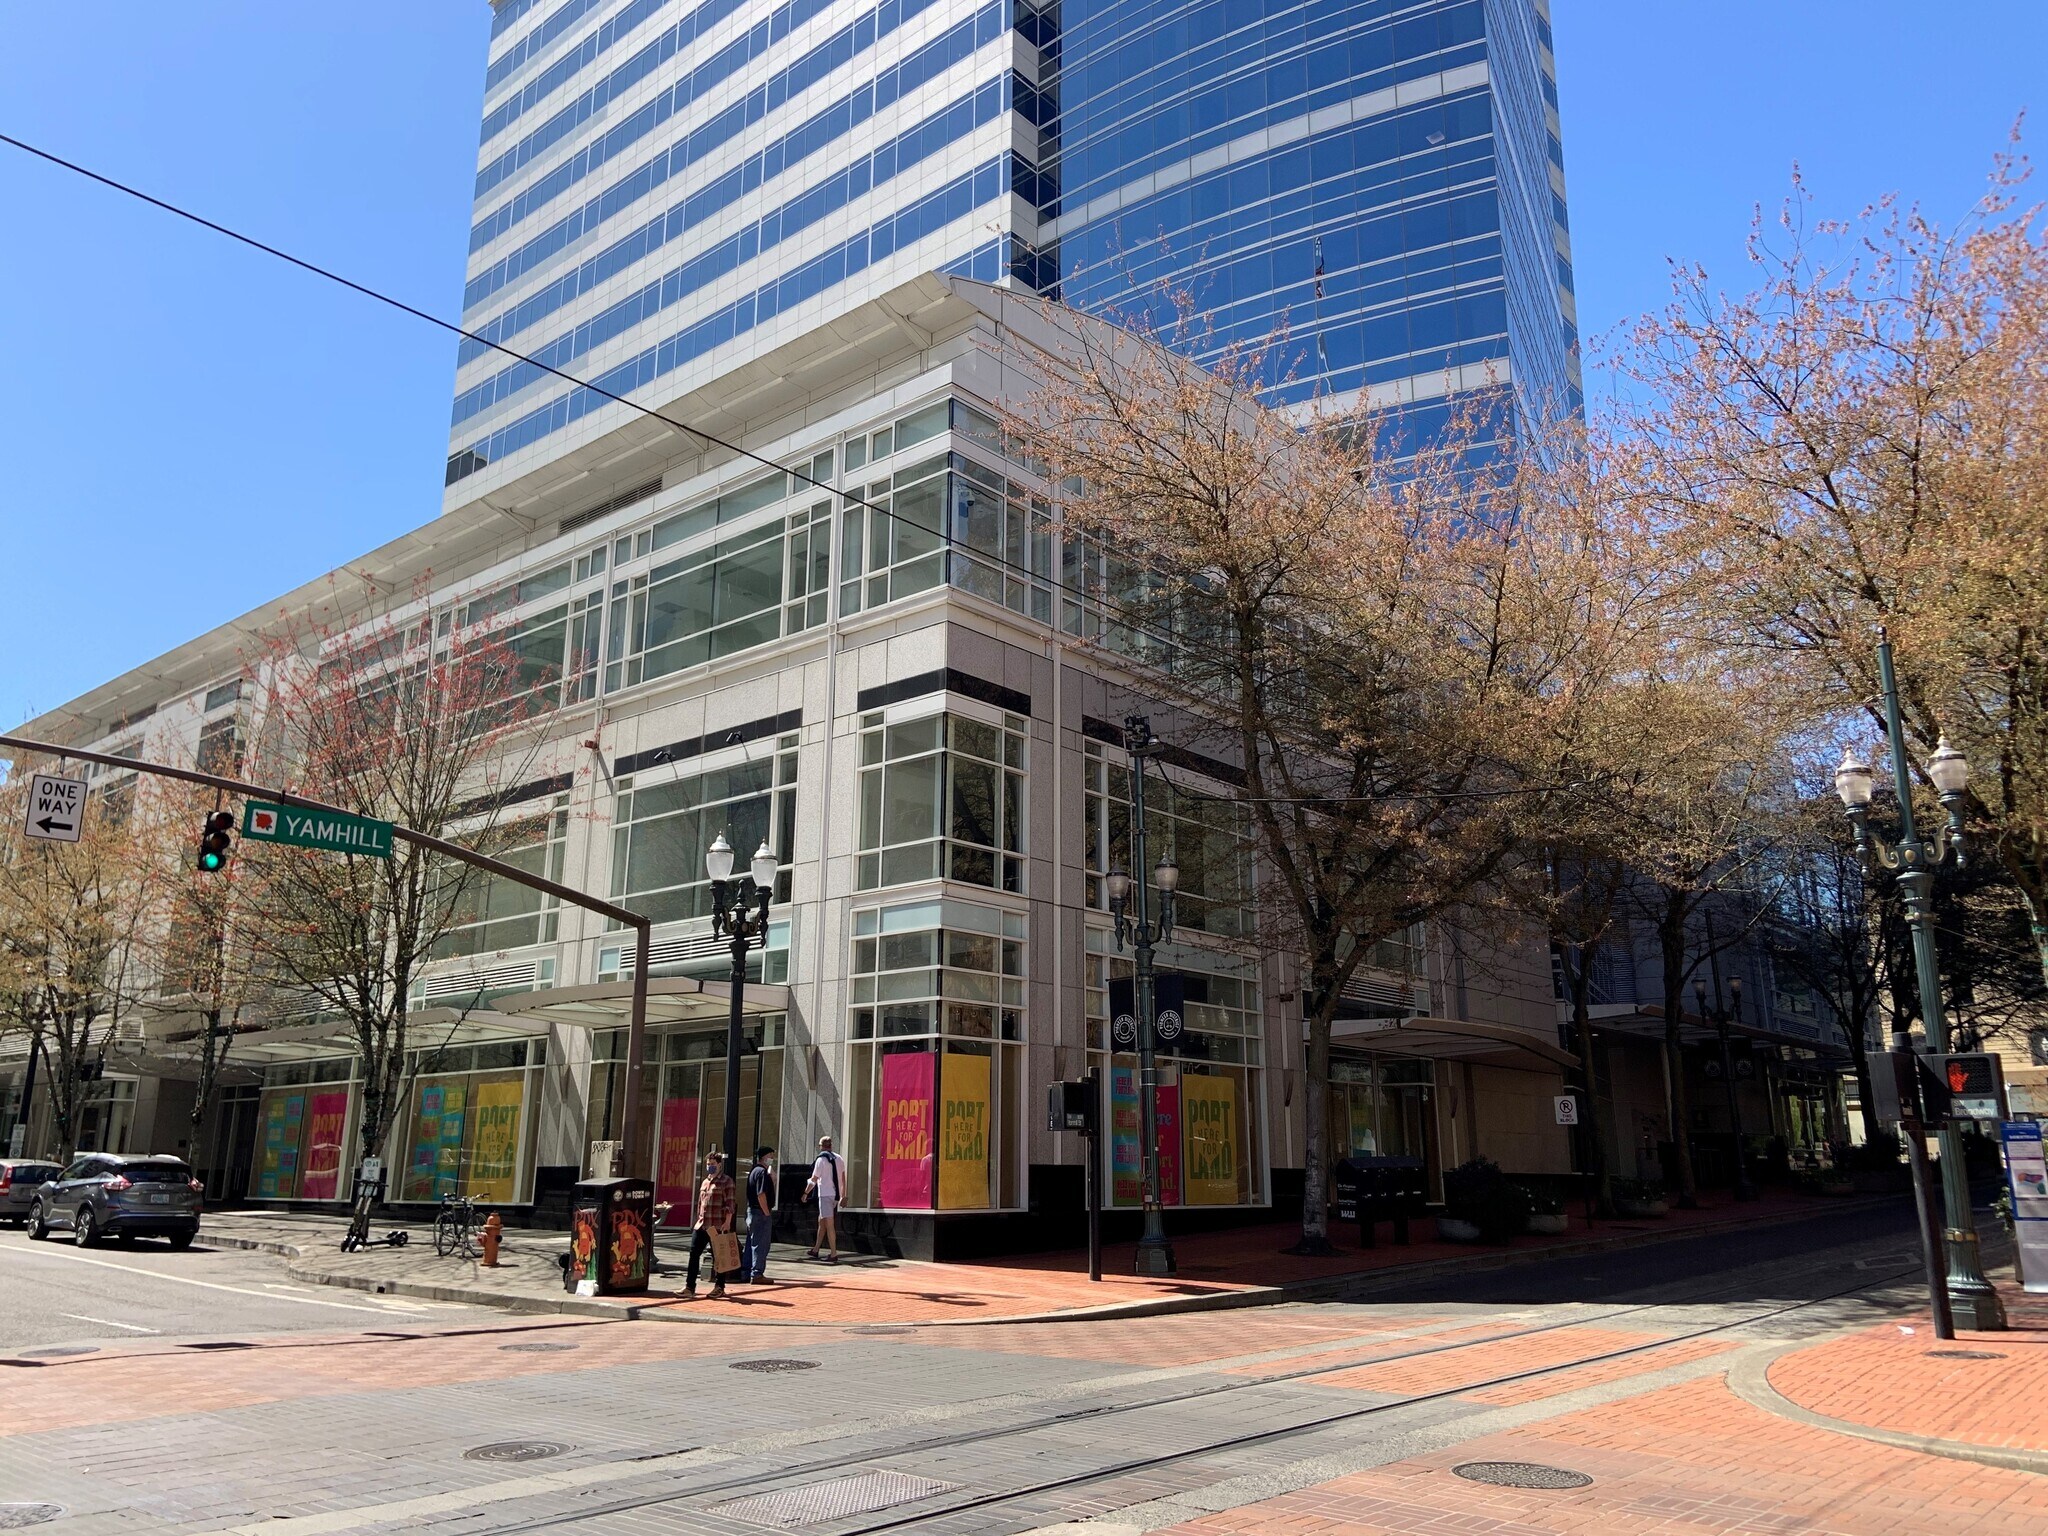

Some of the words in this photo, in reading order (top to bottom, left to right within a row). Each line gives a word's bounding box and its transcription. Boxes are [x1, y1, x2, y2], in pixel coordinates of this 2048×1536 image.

[42, 781, 78, 799] ONE
[38, 797, 77, 816] WAY
[284, 814, 385, 850] YAMHILL
[478, 1105, 519, 1140] PORT
[887, 1099, 929, 1130] PORT
[946, 1100, 985, 1130] PORT
[1188, 1099, 1231, 1140] PORT
[1954, 1107, 1995, 1118] Broadway
[895, 1120, 917, 1131] HERE
[954, 1122, 974, 1133] HERE
[1197, 1128, 1220, 1142] HERE
[486, 1132, 506, 1143] HERE
[886, 1130, 927, 1160] LAND
[900, 1132, 913, 1141] FOR
[945, 1130, 983, 1160] LAND
[958, 1133, 971, 1143] FOR
[1202, 1142, 1217, 1155] FOR
[1188, 1140, 1233, 1180] LAND
[574, 1209, 600, 1232] PDX
[611, 1208, 649, 1233] PDX
